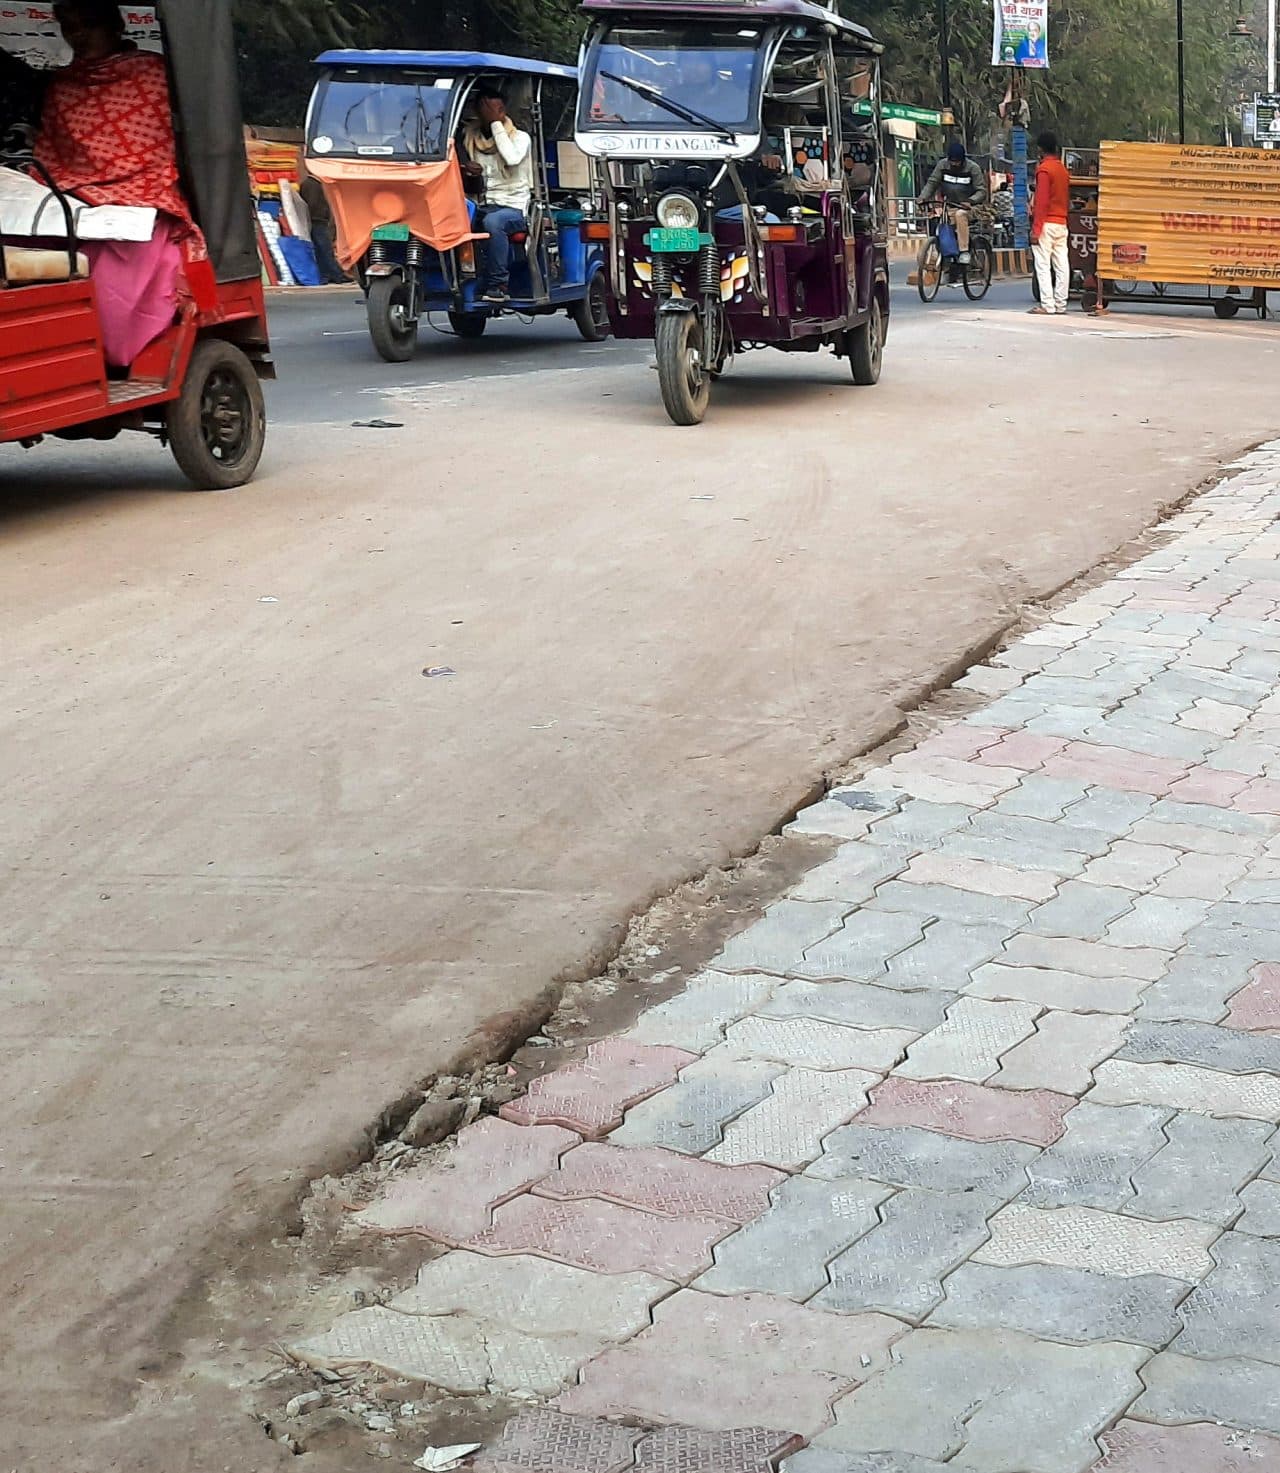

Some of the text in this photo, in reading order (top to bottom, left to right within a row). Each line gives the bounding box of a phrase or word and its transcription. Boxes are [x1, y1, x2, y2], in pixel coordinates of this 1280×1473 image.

[627, 137, 662, 150] ATUT
[1161, 212, 1225, 232] WORK
[1231, 215, 1250, 233] IN
